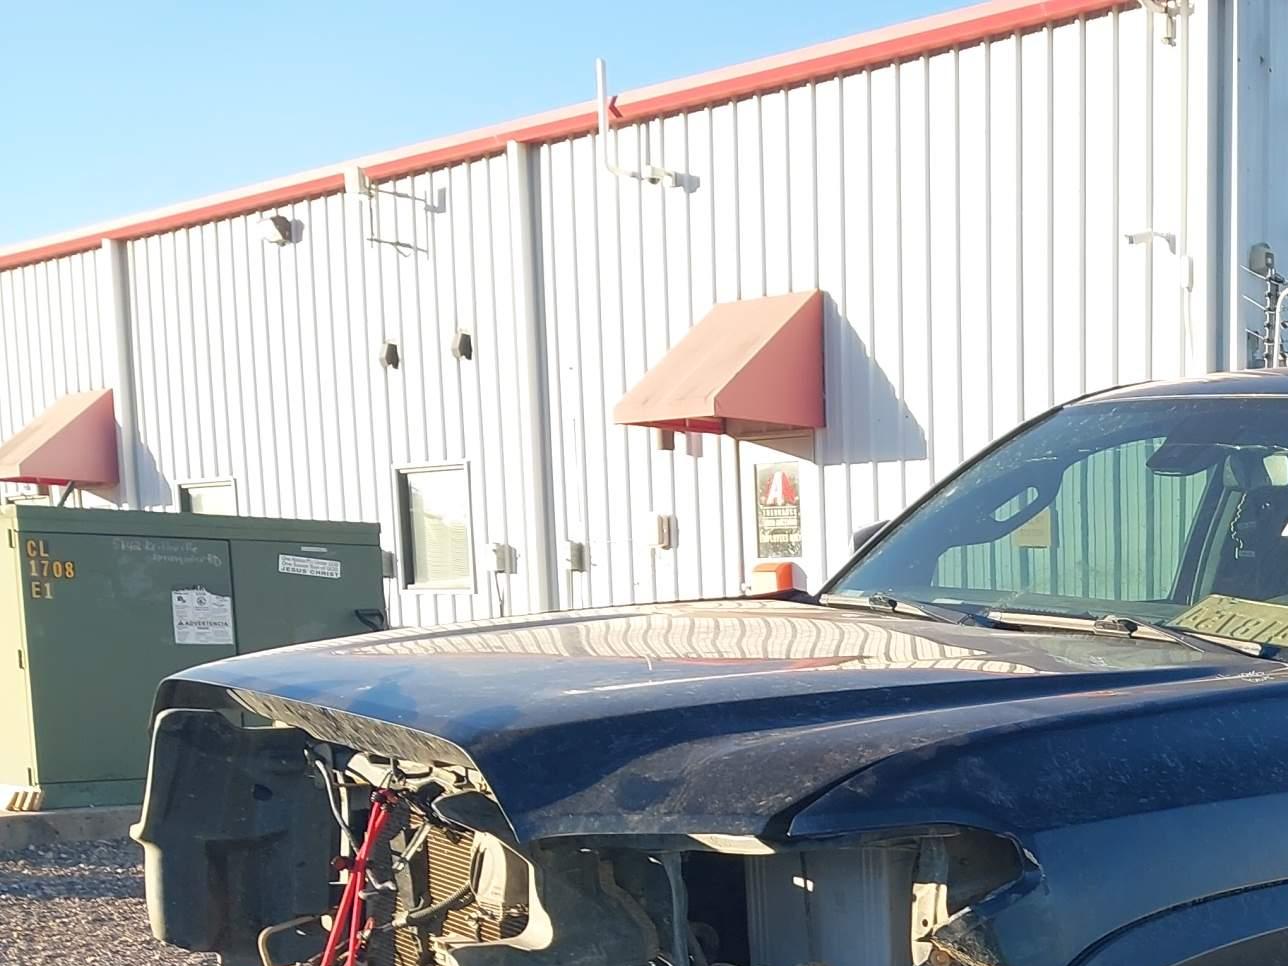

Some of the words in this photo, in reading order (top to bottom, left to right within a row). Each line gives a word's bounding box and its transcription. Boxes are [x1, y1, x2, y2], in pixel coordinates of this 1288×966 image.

[26, 540, 49, 558] CL
[30, 560, 75, 578] 1708
[31, 581, 53, 600] E1
